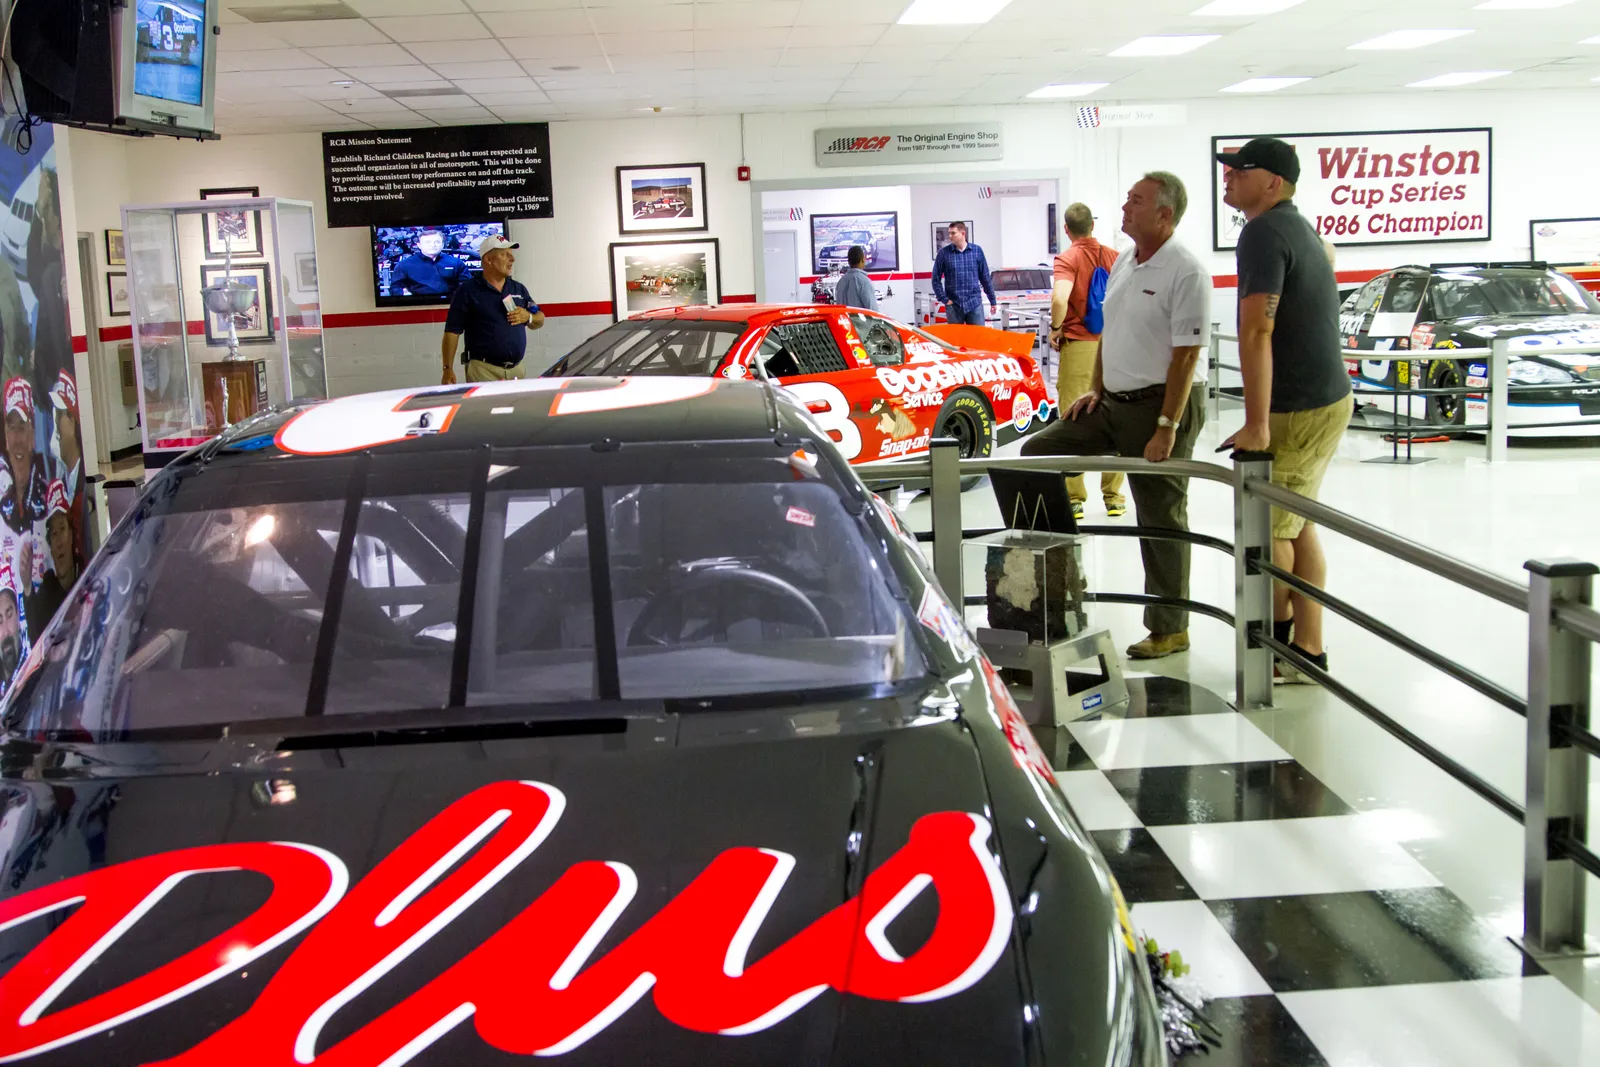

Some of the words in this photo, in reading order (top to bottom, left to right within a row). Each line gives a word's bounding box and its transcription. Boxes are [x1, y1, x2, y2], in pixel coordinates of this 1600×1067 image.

[849, 136, 891, 150] RCR
[914, 134, 945, 143] Original
[947, 132, 975, 141] Engine
[977, 132, 998, 140] Shop
[330, 154, 362, 162] Establish
[363, 153, 391, 161] Richard
[490, 147, 523, 156] respected
[1317, 144, 1480, 179] Winston
[331, 164, 366, 172] successful
[367, 162, 409, 172] organization
[331, 175, 340, 183] by
[341, 174, 374, 183] providing
[423, 170, 466, 179] performance
[402, 180, 435, 189] increased
[436, 179, 476, 189] profitability
[491, 176, 526, 186] prosperity
[373, 192, 404, 200] involved.
[488, 196, 515, 204] Richard
[1330, 186, 1384, 209] Cup
[1389, 182, 1466, 203] Series
[488, 204, 515, 213] January
[1316, 214, 1359, 236] 1986
[1367, 211, 1483, 236] Champion
[991, 382, 1012, 402] Plus
[903, 391, 943, 409] Service
[955, 398, 990, 436] GOODYEAR
[1015, 408, 1030, 420] KING
[0, 782, 1013, 1067] Plus
